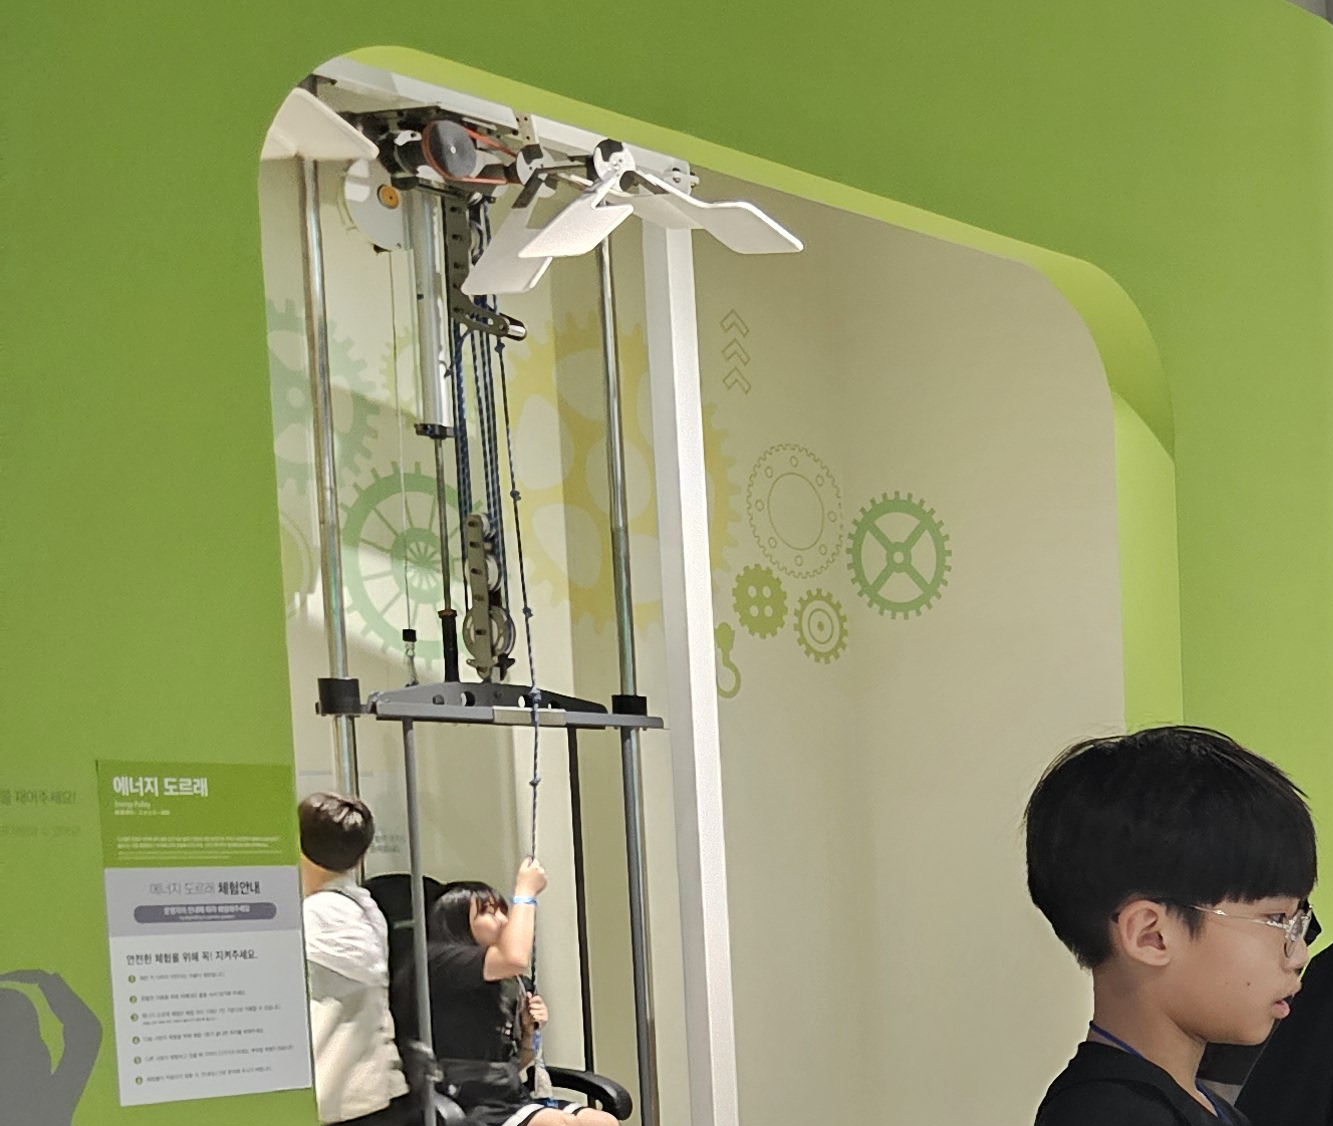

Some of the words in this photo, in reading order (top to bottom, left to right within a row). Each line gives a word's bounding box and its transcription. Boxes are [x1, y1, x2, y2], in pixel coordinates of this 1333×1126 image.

[112, 776, 159, 798] 에너지
[163, 777, 209, 798] 도르래
[217, 880, 262, 896] 체험안내
[127, 953, 152, 966] 안전한
[155, 951, 180, 965] 체험을
[183, 951, 199, 963] 위해
[202, 951, 213, 963] 꼭!
[215, 949, 259, 962] 지켜주세요.
